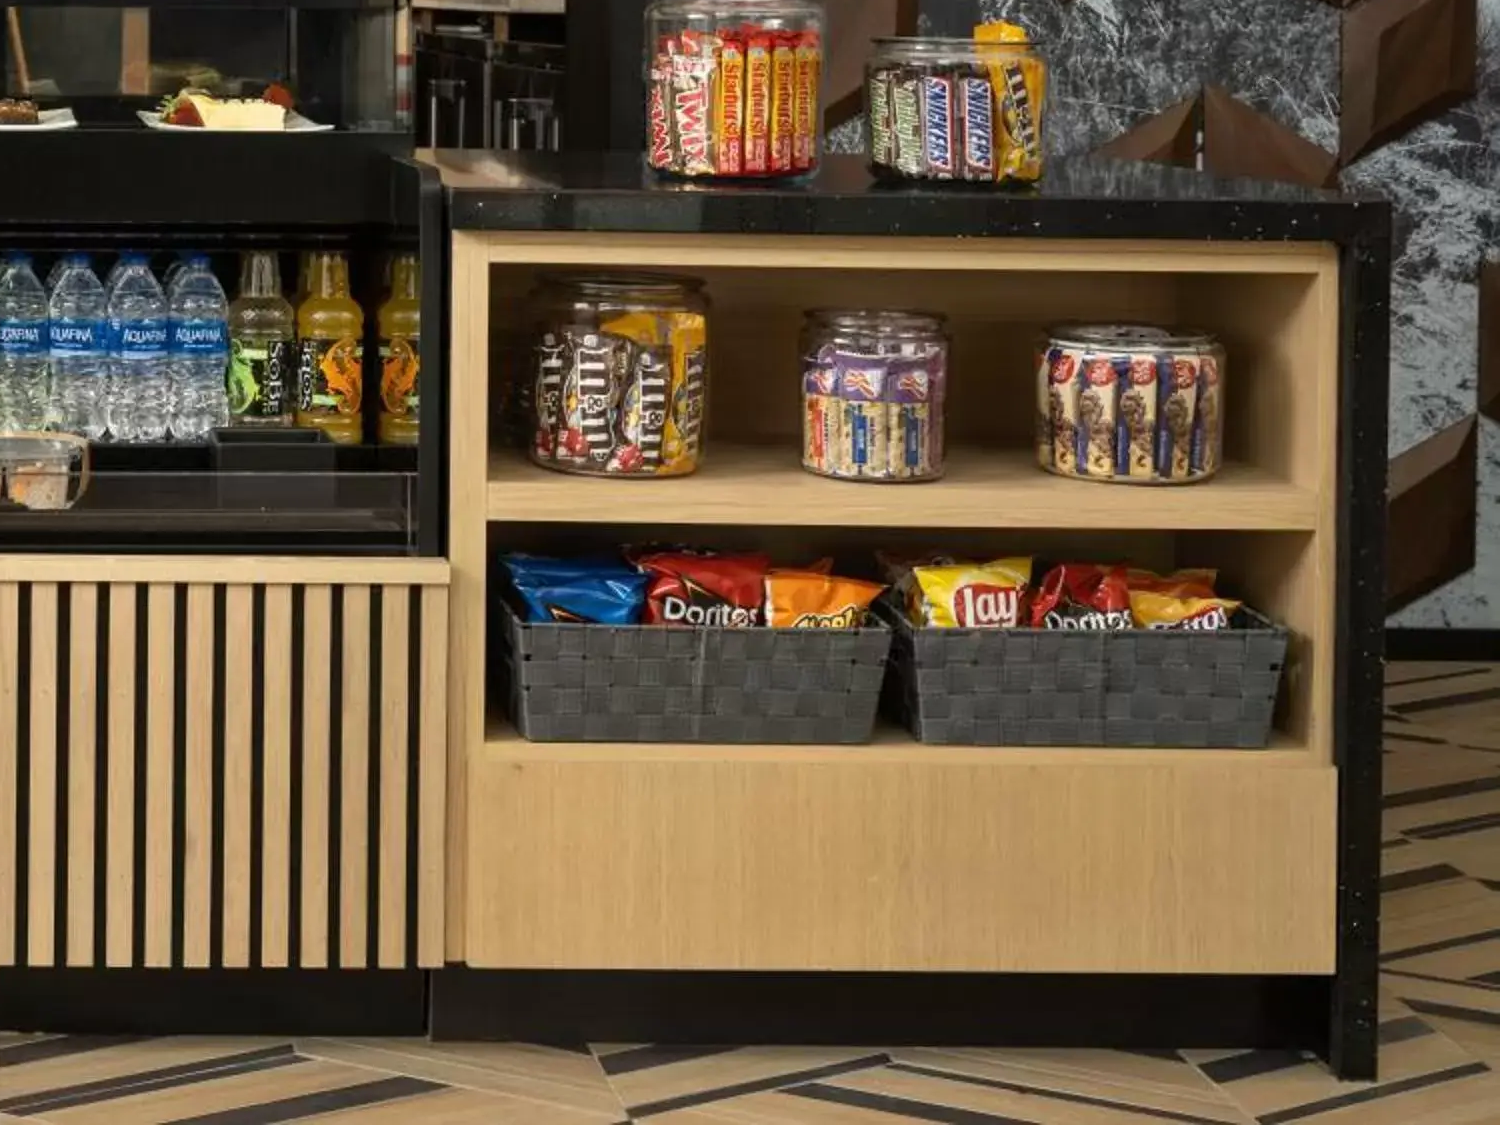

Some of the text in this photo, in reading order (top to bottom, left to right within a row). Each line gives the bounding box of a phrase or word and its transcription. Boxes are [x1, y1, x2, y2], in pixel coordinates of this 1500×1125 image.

[927, 79, 949, 166] SNICKERS
[967, 78, 991, 167] SNICKERS
[175, 326, 223, 343] AQUAFINA
[663, 595, 759, 628] Doritos
